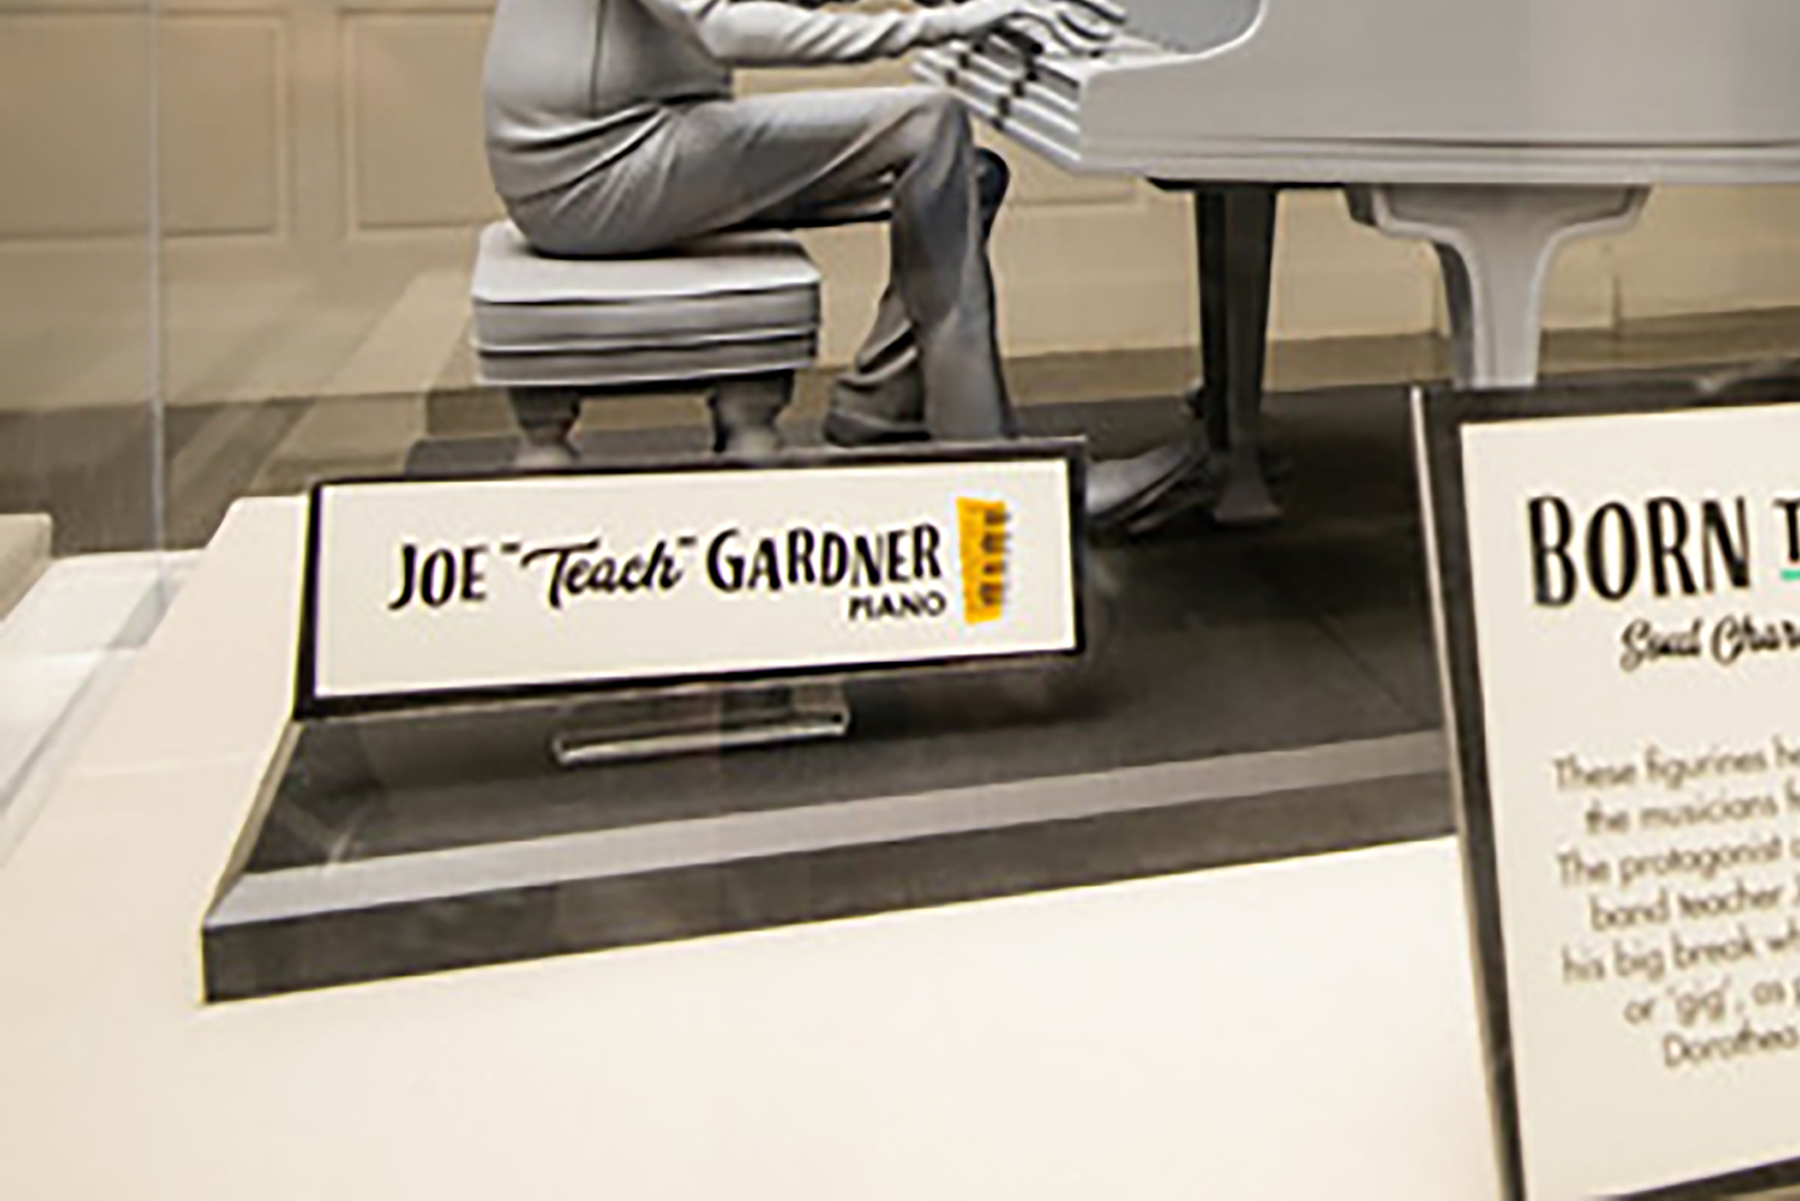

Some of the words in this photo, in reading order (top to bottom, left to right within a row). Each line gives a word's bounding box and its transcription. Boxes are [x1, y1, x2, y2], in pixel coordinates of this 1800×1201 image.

[390, 543, 489, 611] JOE
[706, 522, 943, 595] GARDNER
[1527, 495, 1752, 608] BORN
[848, 590, 947, 622] PIANO
[1619, 617, 1702, 673] Soul
[1552, 752, 1637, 791] These
[1645, 741, 1768, 791] figurines
[1585, 799, 1631, 836] the
[1639, 787, 1778, 829] musicians
[1556, 847, 1613, 889] The
[1618, 833, 1784, 890] protagonist
[1588, 885, 1671, 933] band
[1678, 875, 1784, 919] teacher
[1614, 937, 1667, 984] big
[1671, 921, 1755, 971] break
[1623, 996, 1654, 1026] or
[1751, 979, 1787, 1007] as
[1660, 1016, 1800, 1069] Dorothea
